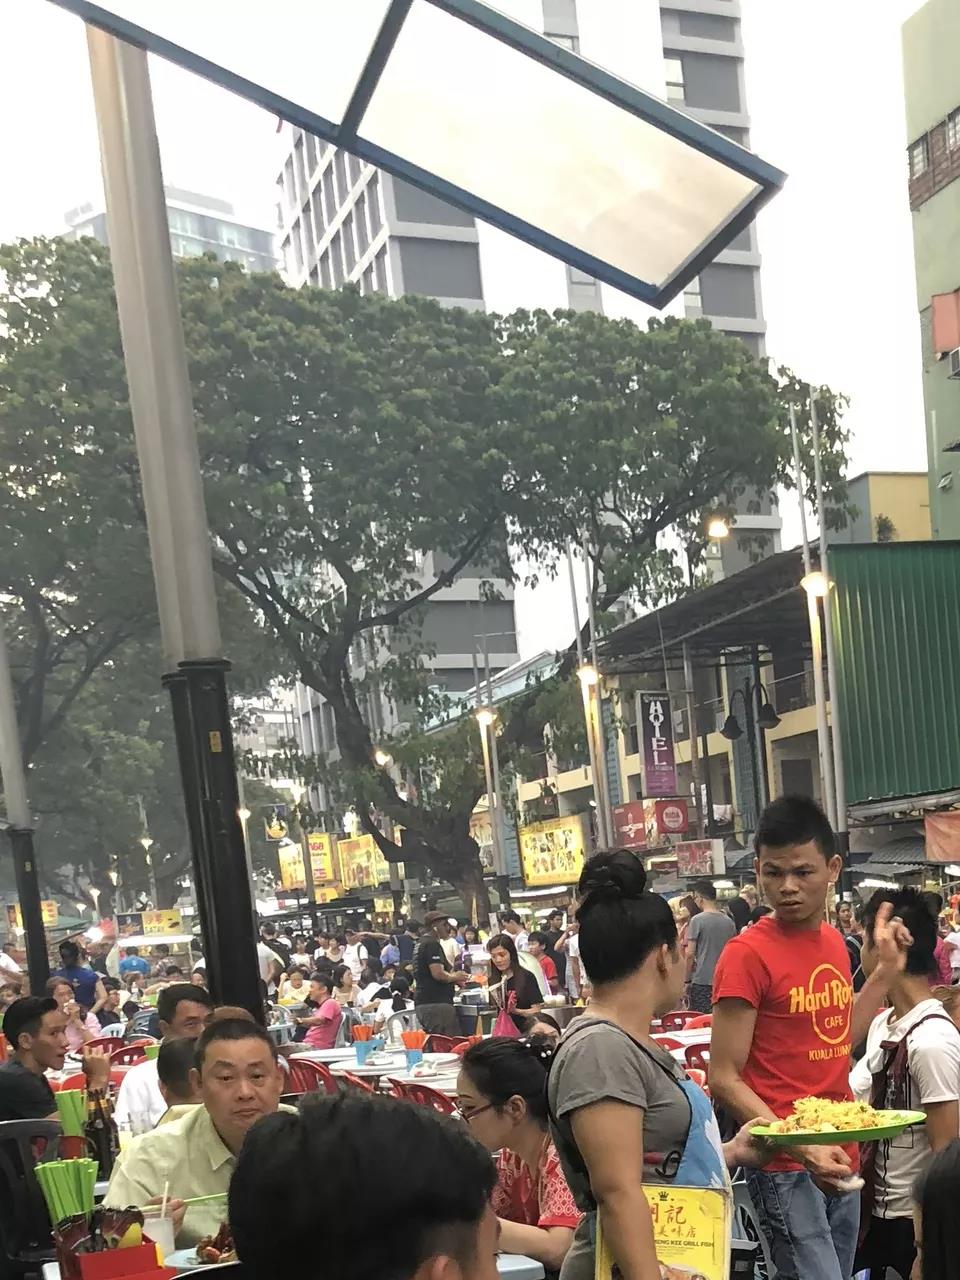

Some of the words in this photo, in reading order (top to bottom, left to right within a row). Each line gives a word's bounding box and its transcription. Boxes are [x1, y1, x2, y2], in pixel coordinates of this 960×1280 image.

[648, 701, 667, 765] HOTEL
[789, 982, 830, 1013] Hard
[824, 1015, 843, 1029] CAFE
[809, 1048, 833, 1061] KUALA
